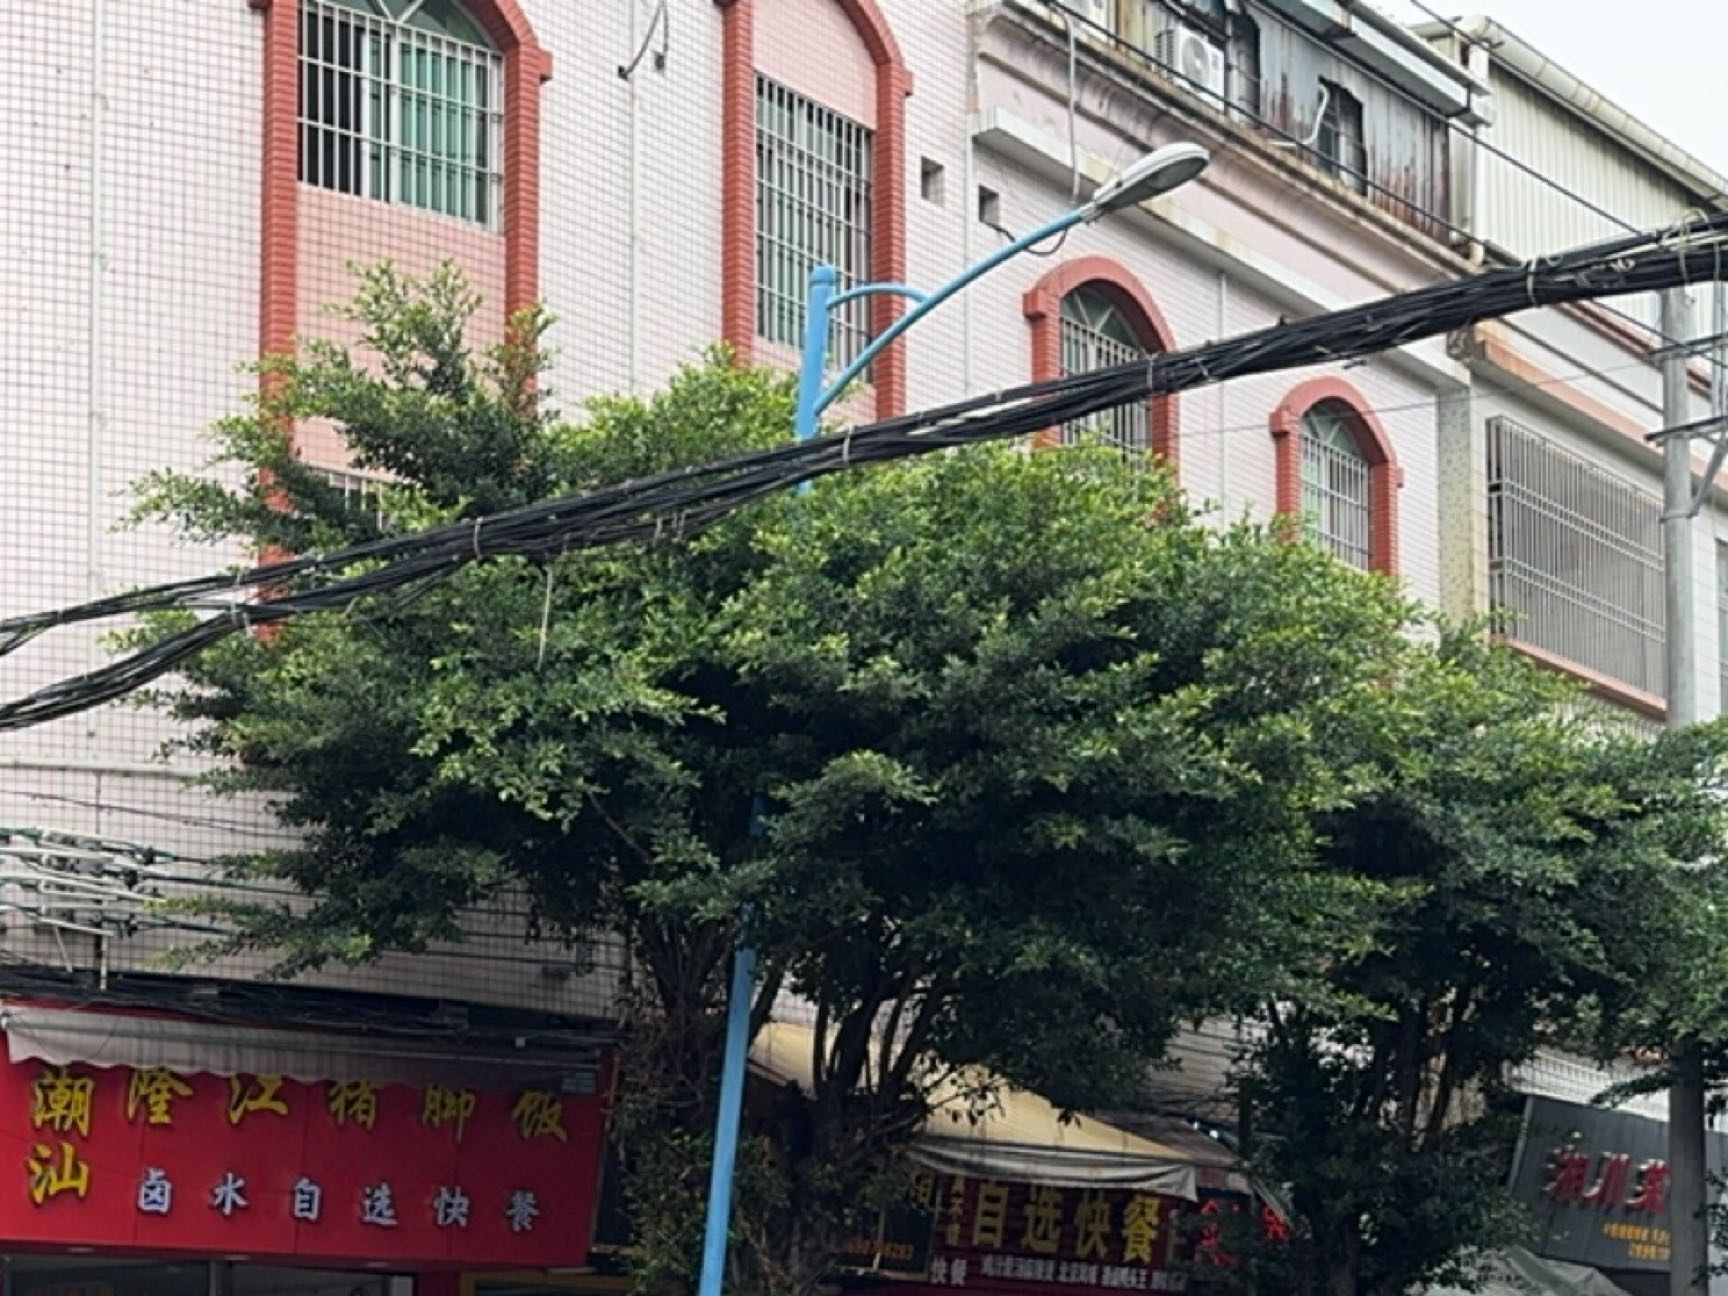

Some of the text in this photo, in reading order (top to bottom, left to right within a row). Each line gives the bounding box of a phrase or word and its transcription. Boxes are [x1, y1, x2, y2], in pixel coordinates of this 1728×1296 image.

[137, 1168, 540, 1232] 卤水自选快餐
[972, 1177, 1162, 1264] 自选快餐
